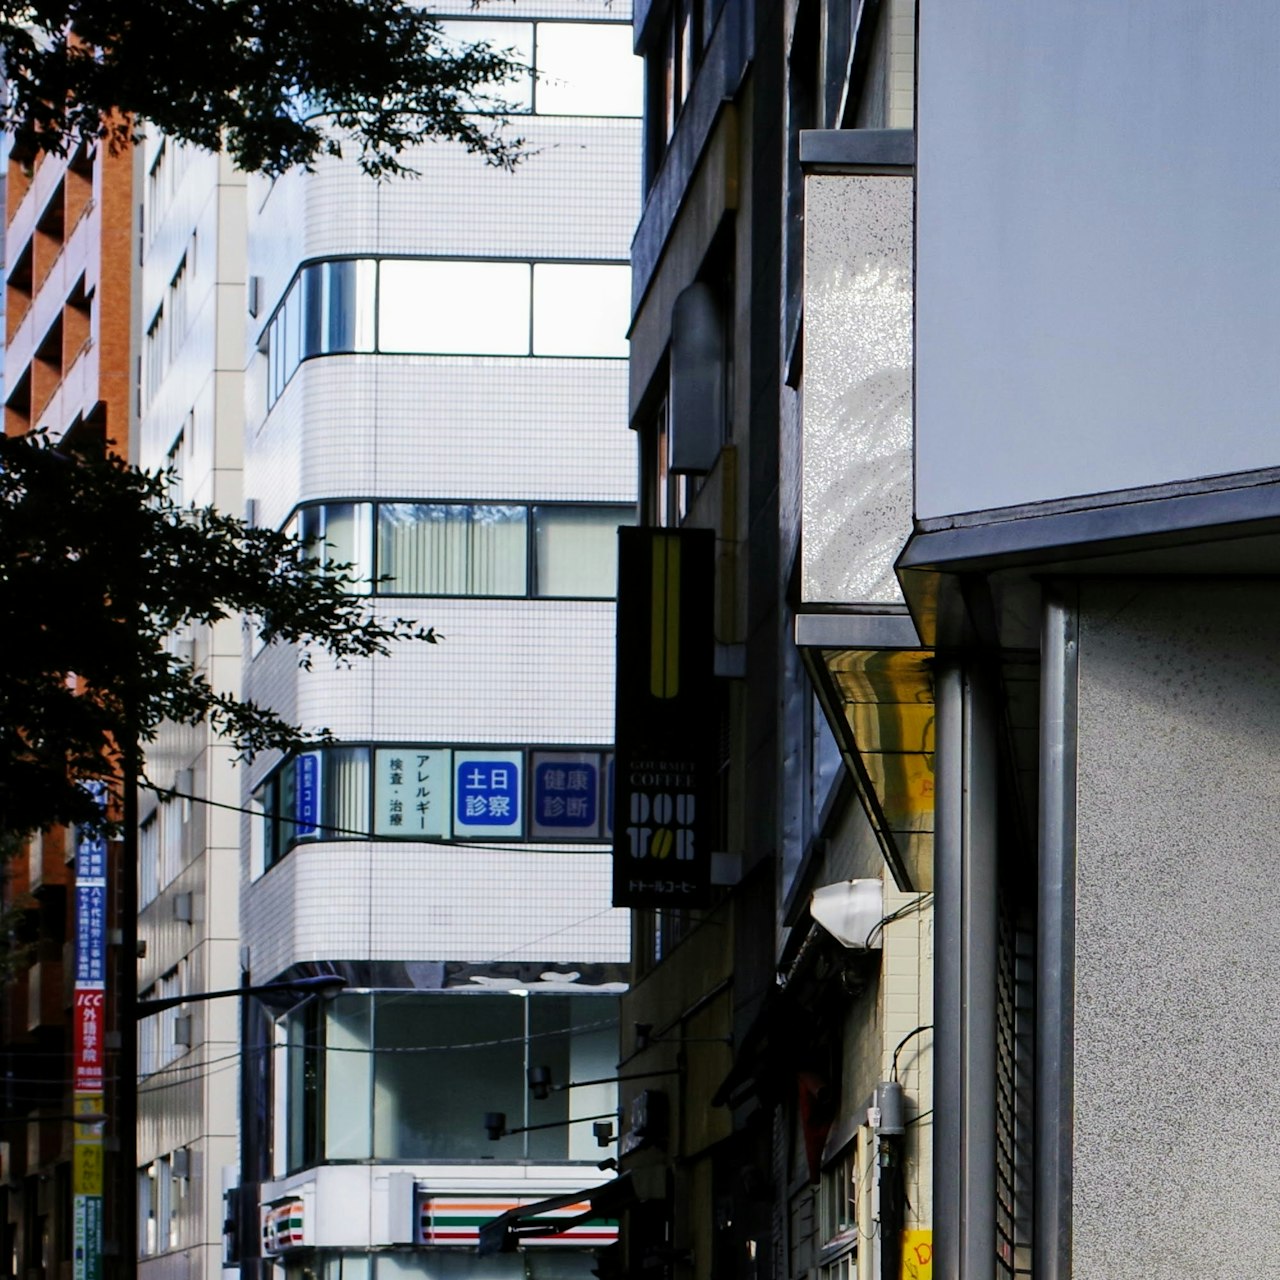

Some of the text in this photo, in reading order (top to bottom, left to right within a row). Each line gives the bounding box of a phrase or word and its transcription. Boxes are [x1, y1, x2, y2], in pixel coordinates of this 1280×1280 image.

[630, 760, 696, 773] GOURMET
[465, 768, 508, 790] 土日
[543, 769, 589, 791] 健康
[630, 772, 697, 788] COFFEE
[389, 757, 403, 826] 検査・治療
[416, 754, 431, 829] アレルギー
[465, 795, 510, 818] 診察
[543, 796, 588, 819] 診断
[629, 791, 696, 826] DOU
[628, 880, 697, 893] ドトールコーヒー
[77, 994, 103, 1006] ICC
[82, 1007, 97, 1063] 外語学院
